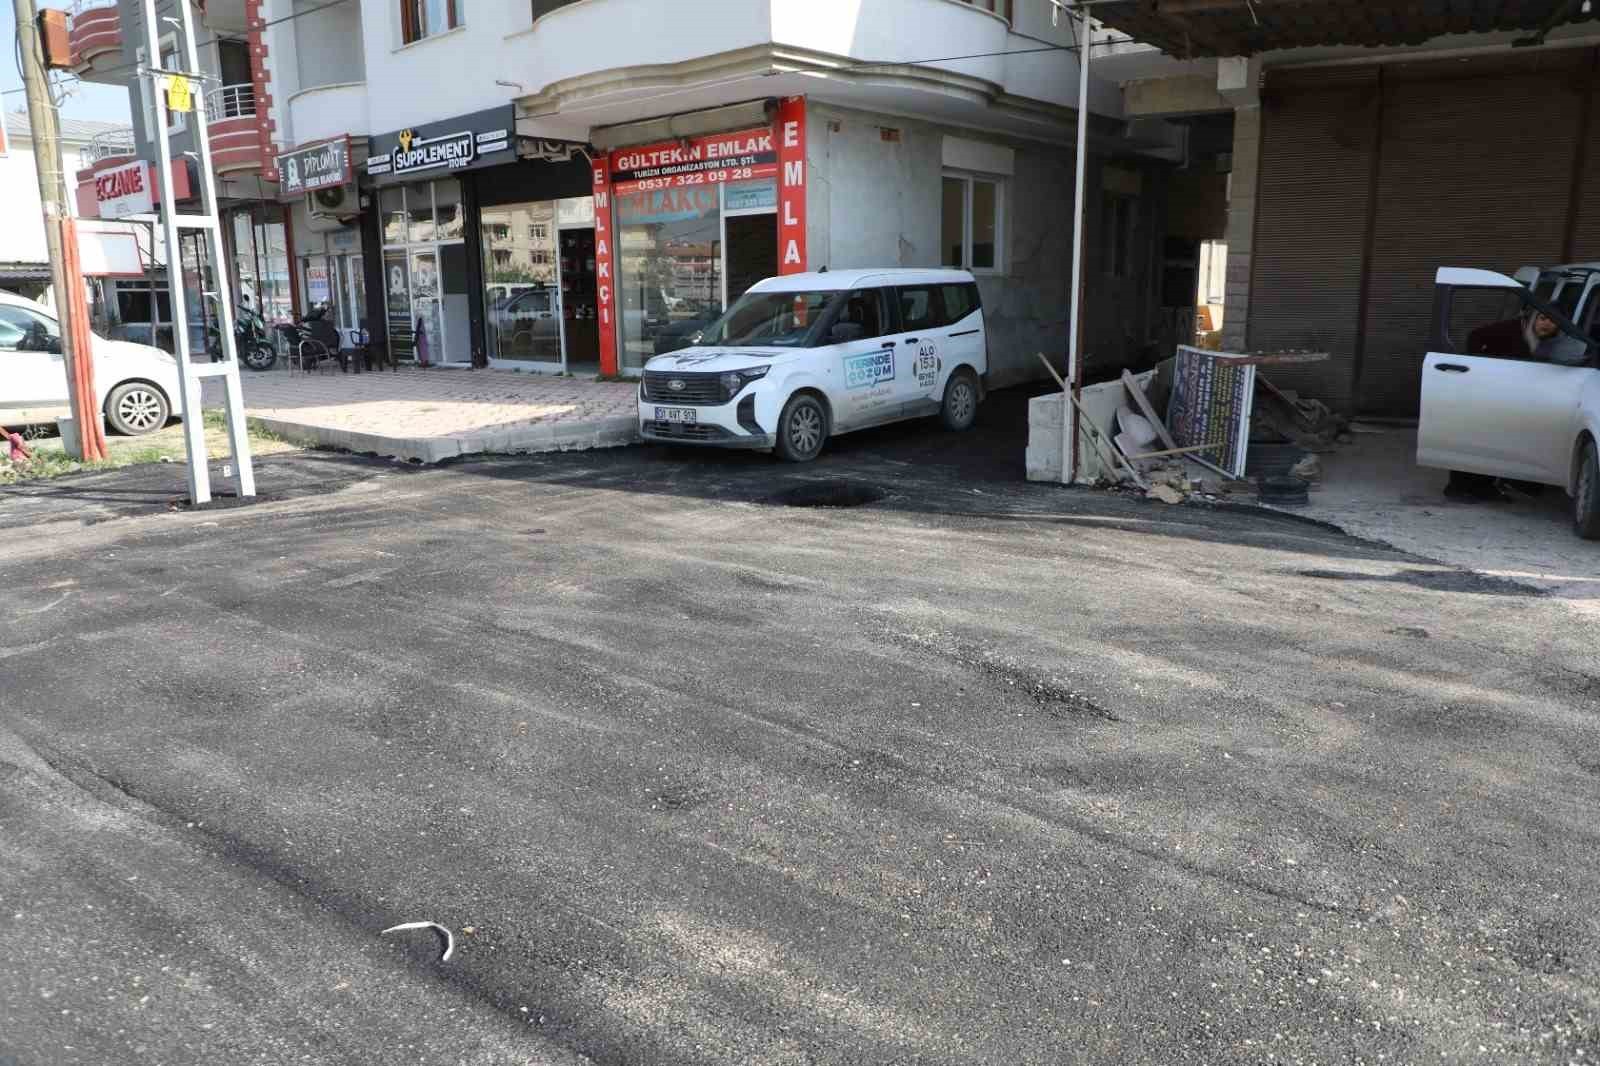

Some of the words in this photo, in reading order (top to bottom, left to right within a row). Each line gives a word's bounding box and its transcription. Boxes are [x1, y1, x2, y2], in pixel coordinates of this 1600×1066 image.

[396, 140, 469, 168] SUPPLEMENT
[707, 135, 773, 158] EMLAK
[638, 177, 672, 191] 0537
[676, 174, 704, 186] 322
[708, 171, 727, 182] 09
[732, 168, 752, 179] 28
[661, 160, 720, 176] ORGANİZASYON
[96, 166, 143, 201] ECZANE
[594, 168, 609, 324] EMLAKÇI
[920, 345, 935, 356] ALO
[920, 356, 935, 369] 153
